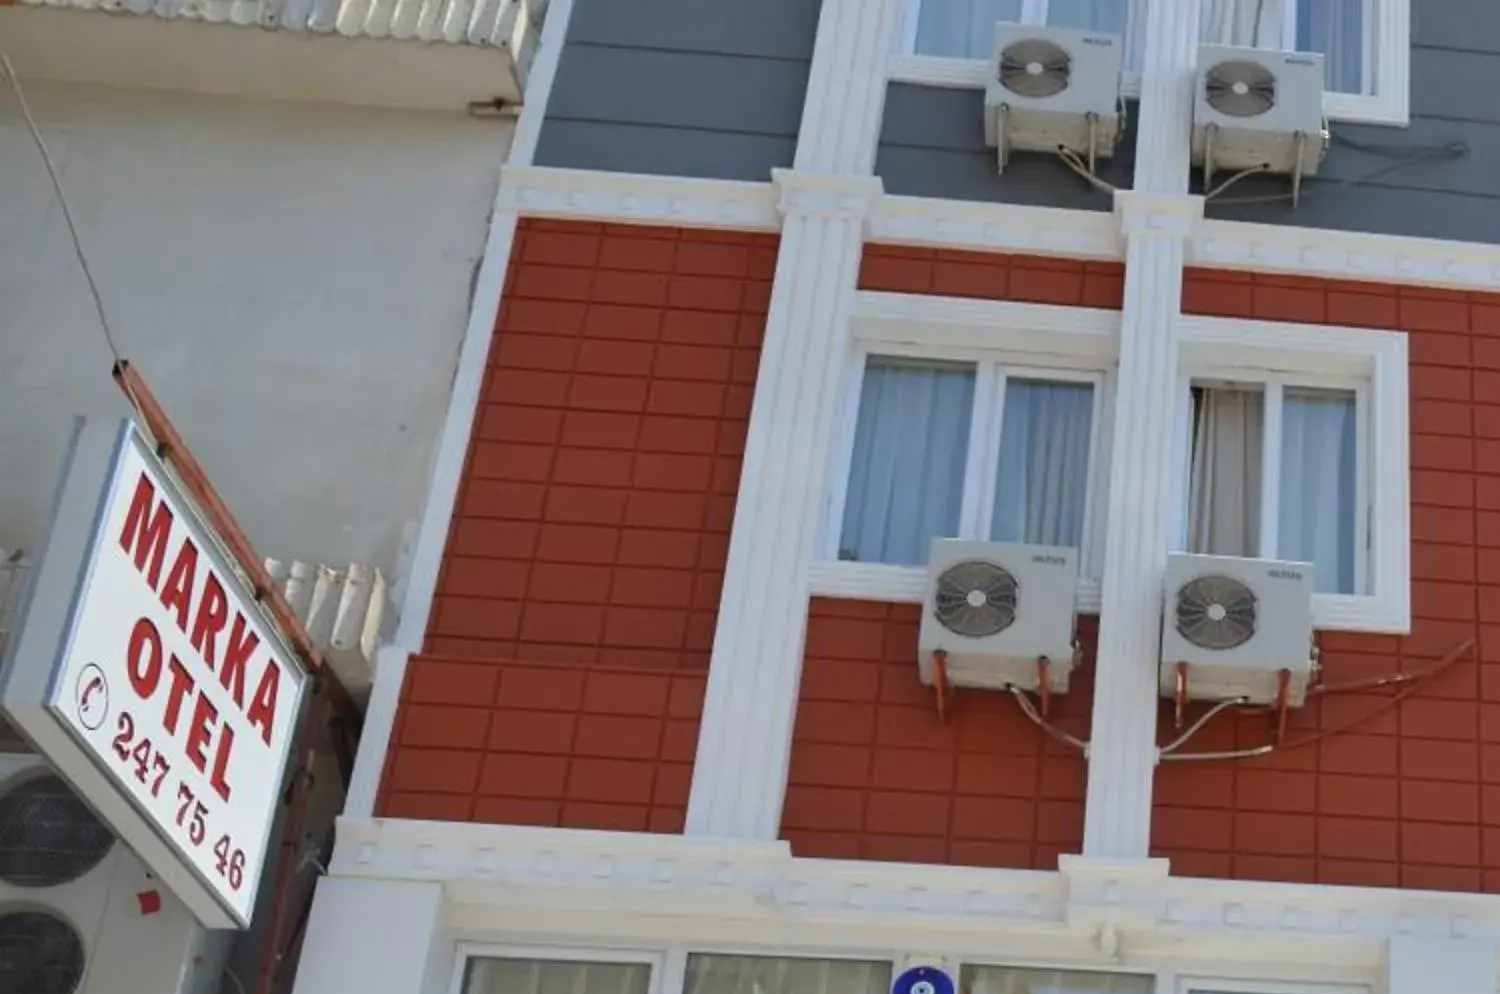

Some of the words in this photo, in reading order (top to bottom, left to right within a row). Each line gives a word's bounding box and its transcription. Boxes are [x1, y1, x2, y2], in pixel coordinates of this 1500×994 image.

[119, 471, 283, 747] MARKA
[127, 617, 233, 801] OTEL
[111, 712, 171, 797] 247
[177, 784, 210, 846] 75
[213, 834, 246, 891] 46
